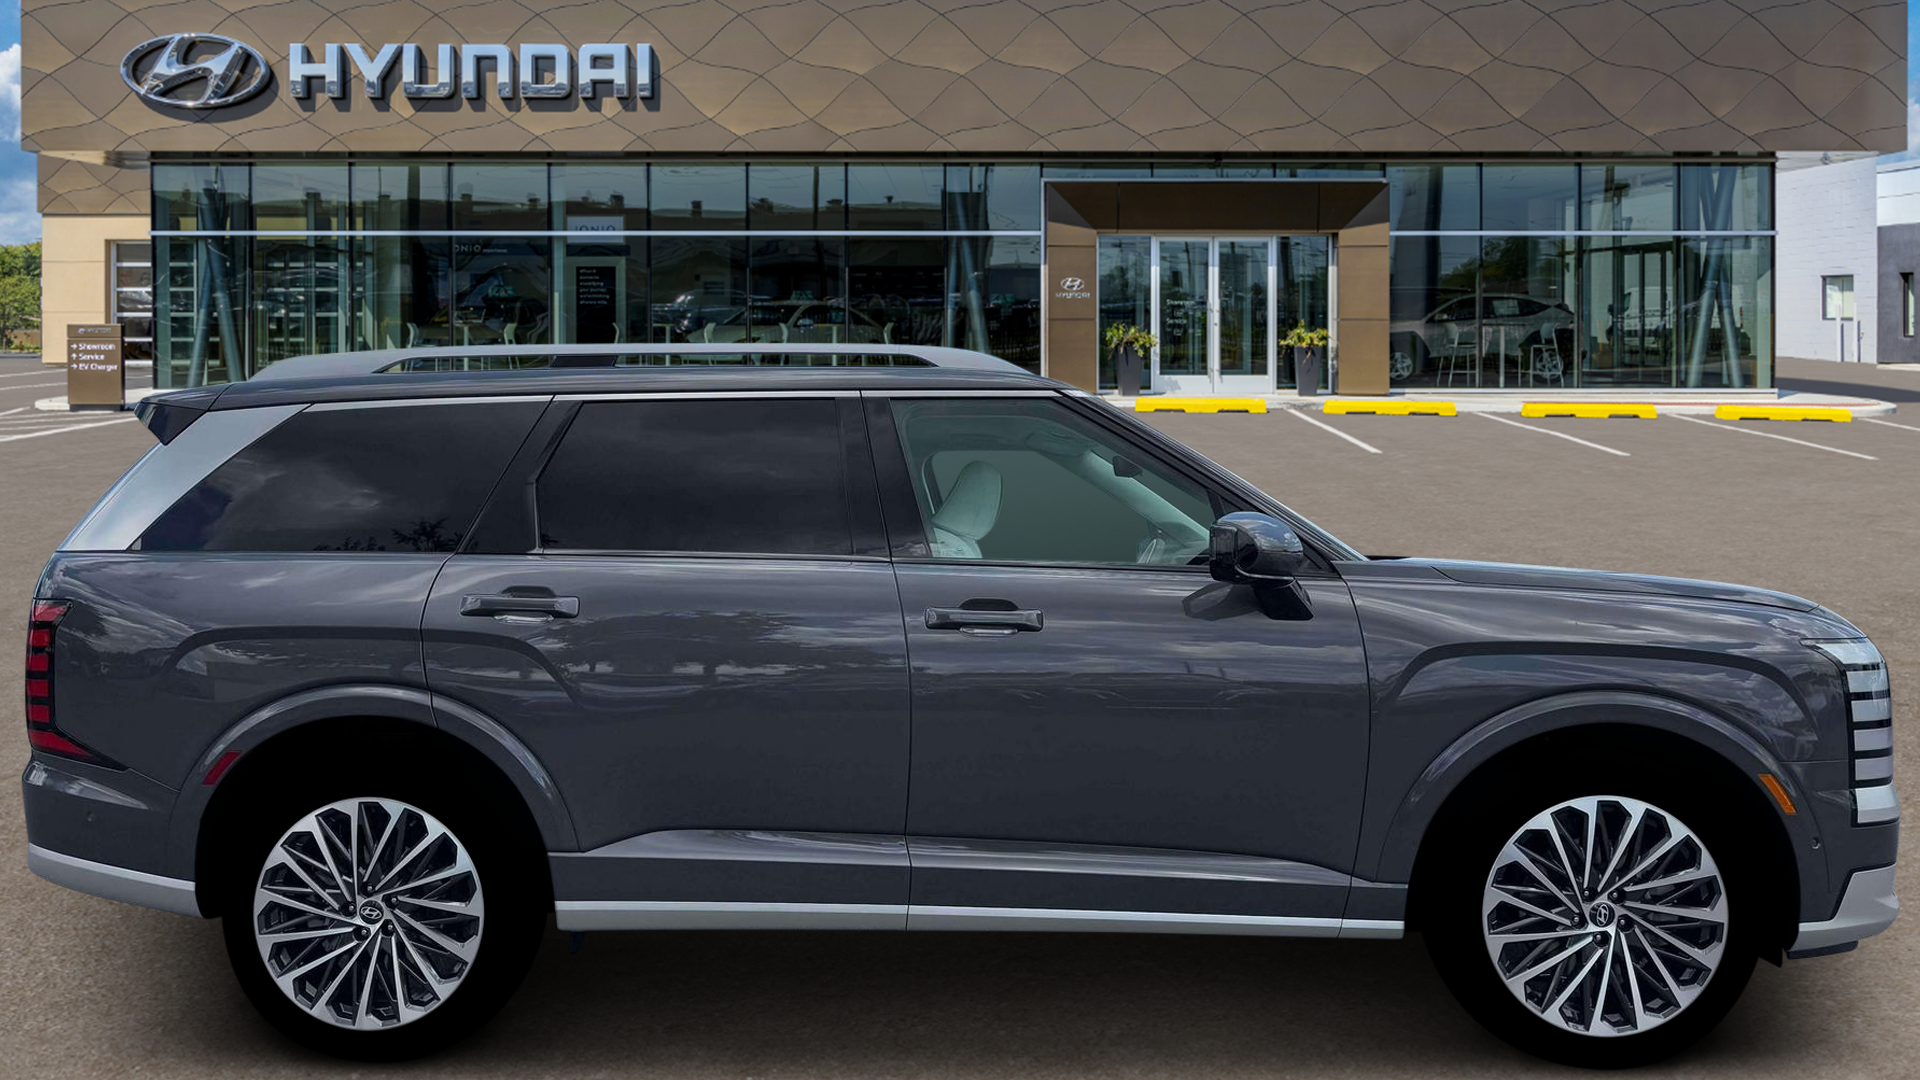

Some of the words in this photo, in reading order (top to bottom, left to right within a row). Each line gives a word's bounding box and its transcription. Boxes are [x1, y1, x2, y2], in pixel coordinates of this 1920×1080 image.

[289, 43, 655, 99] HYUNDAI
[78, 352, 105, 360] Service
[90, 363, 118, 372] Charger
